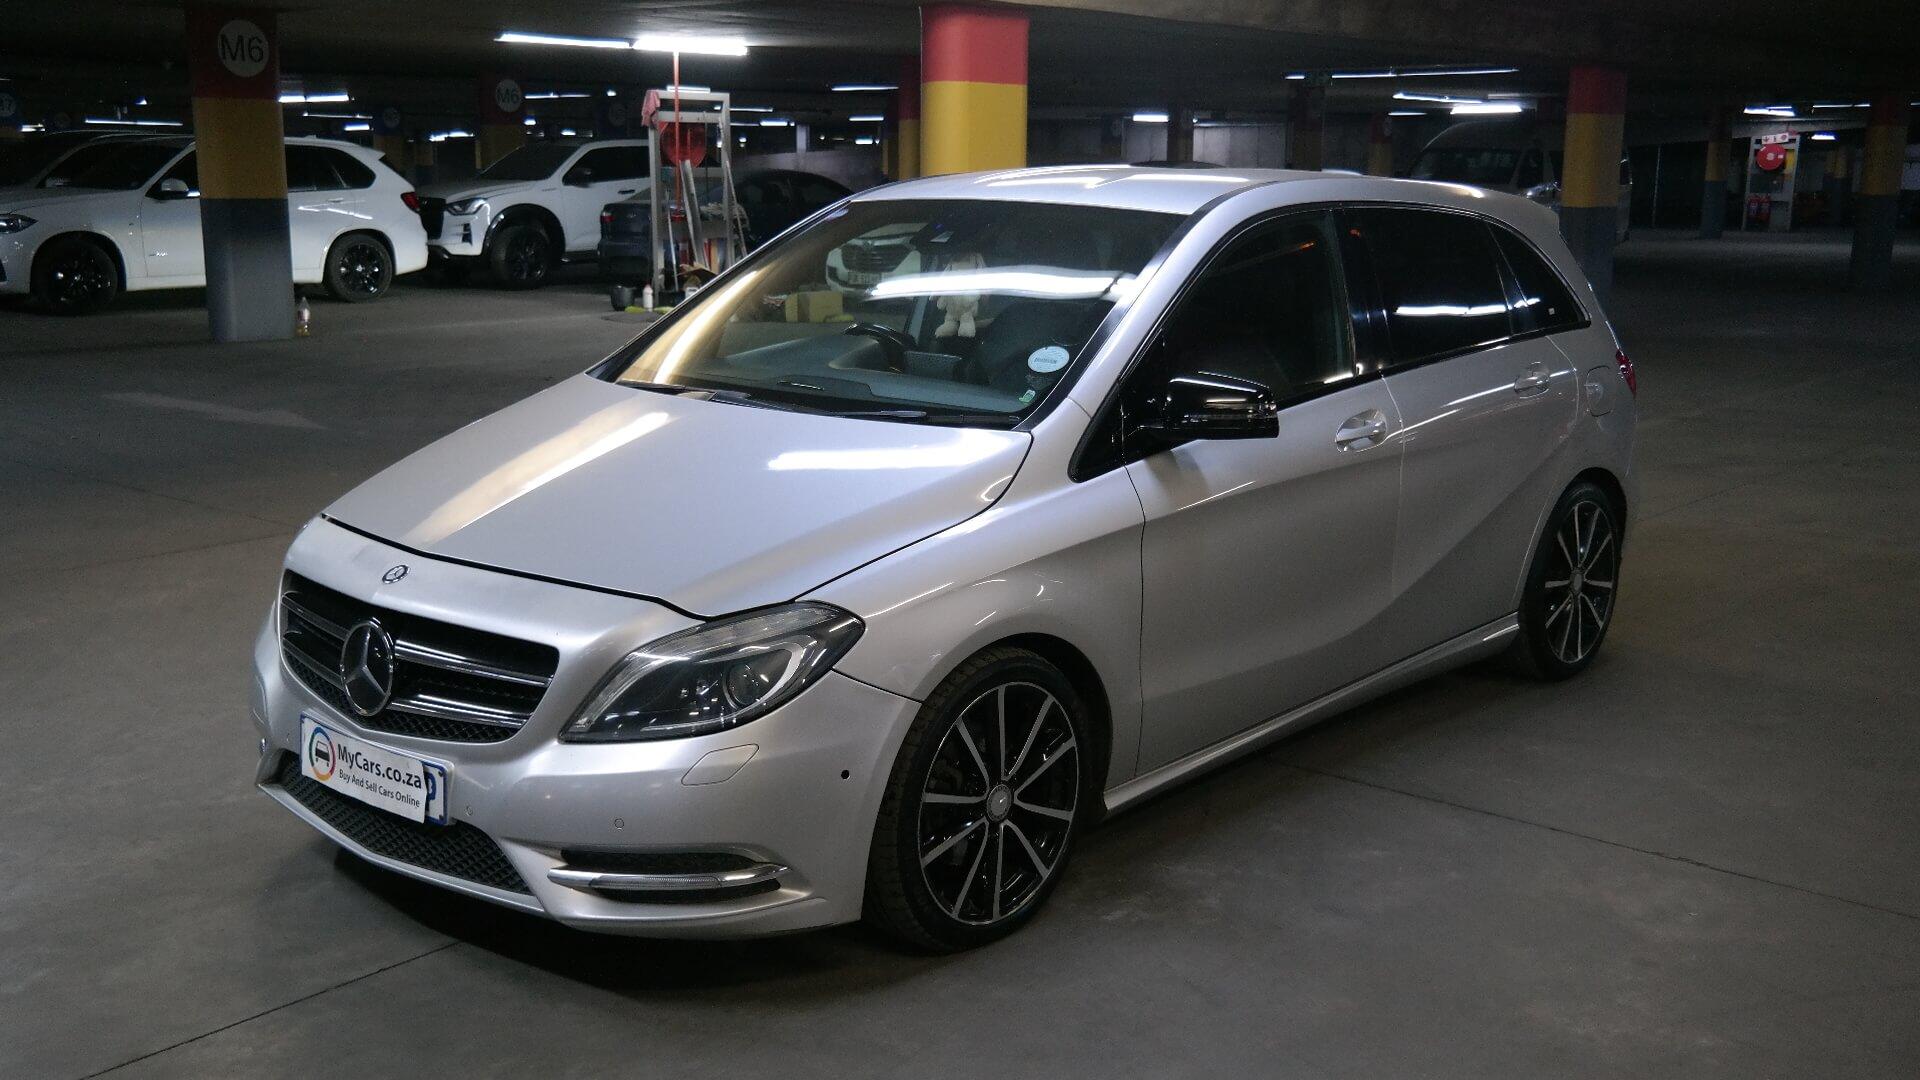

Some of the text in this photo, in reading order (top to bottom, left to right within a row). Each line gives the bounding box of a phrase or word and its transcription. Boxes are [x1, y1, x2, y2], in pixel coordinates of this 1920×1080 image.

[220, 34, 264, 63] M6
[497, 87, 519, 104] M6
[337, 743, 422, 789] MyCars.co.za
[339, 769, 421, 808] Buy And Sell Cars Online
